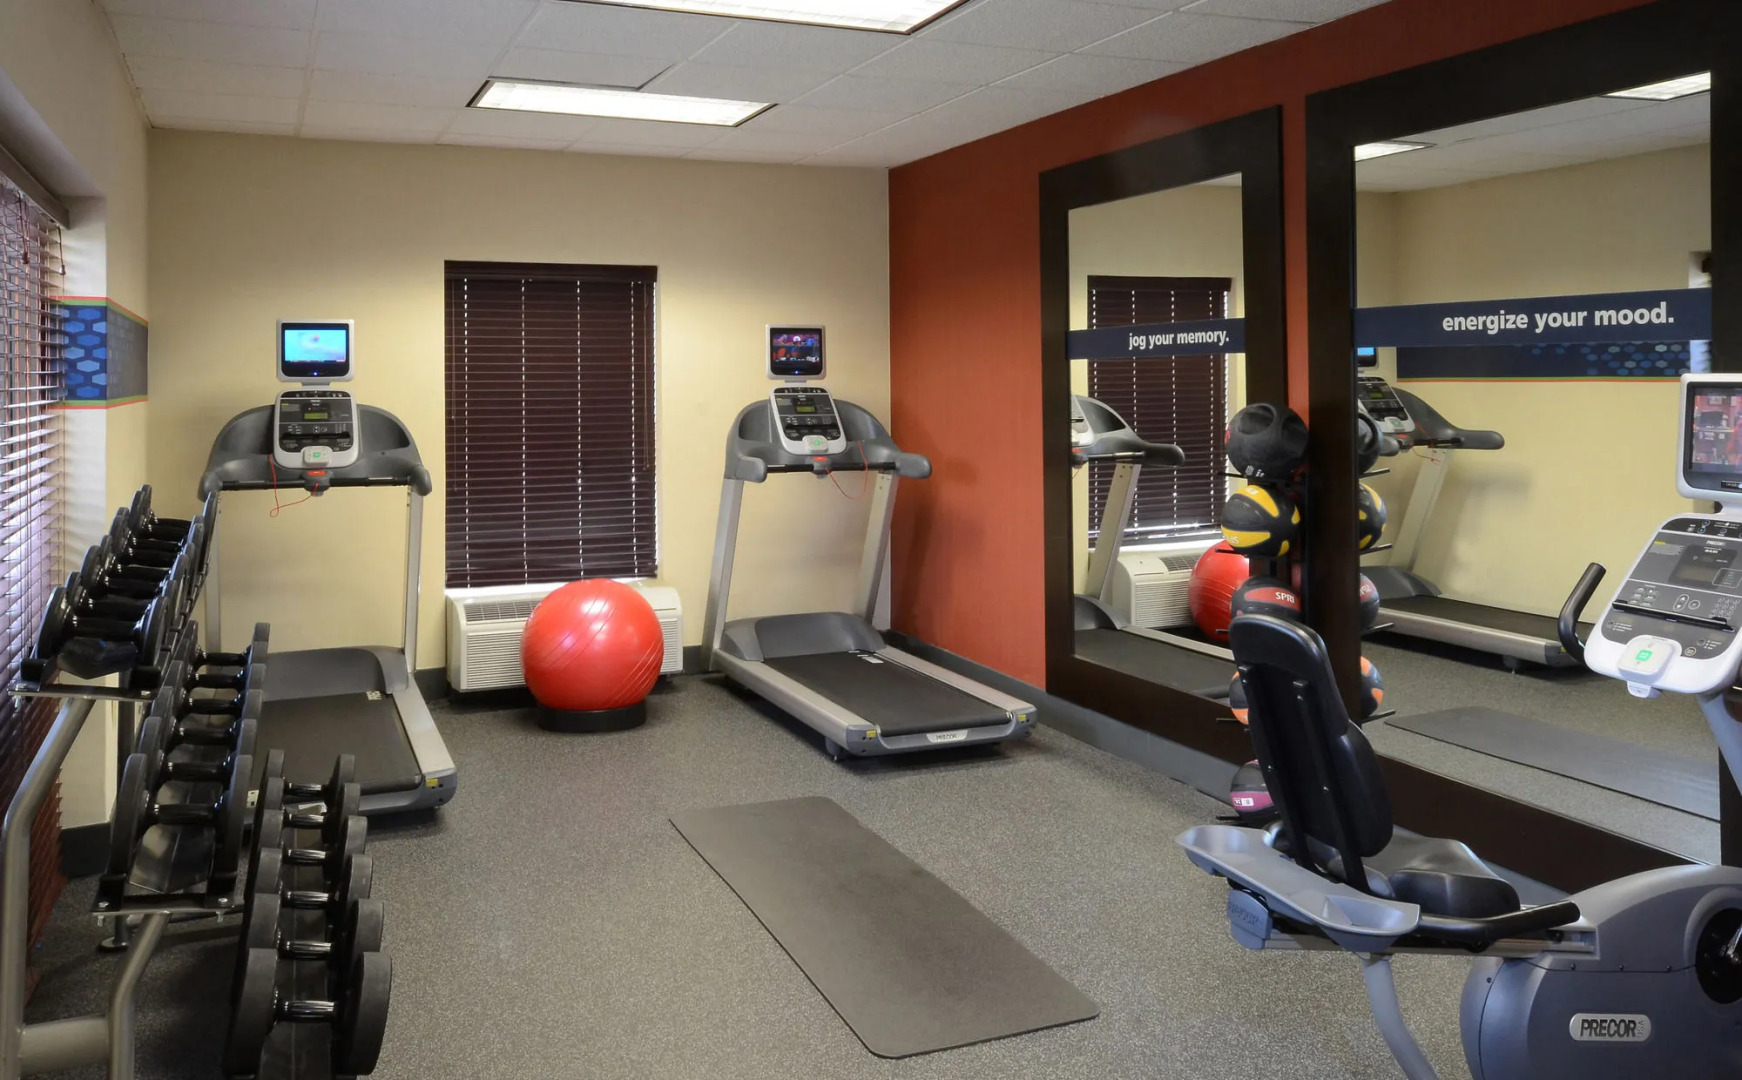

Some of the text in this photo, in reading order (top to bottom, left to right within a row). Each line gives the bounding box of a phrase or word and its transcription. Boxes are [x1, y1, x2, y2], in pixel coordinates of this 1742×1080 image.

[1442, 301, 1674, 334] energize your mood.
[1129, 330, 1229, 350] jog your memory.
[1581, 1018, 1636, 1037] PRECOR
